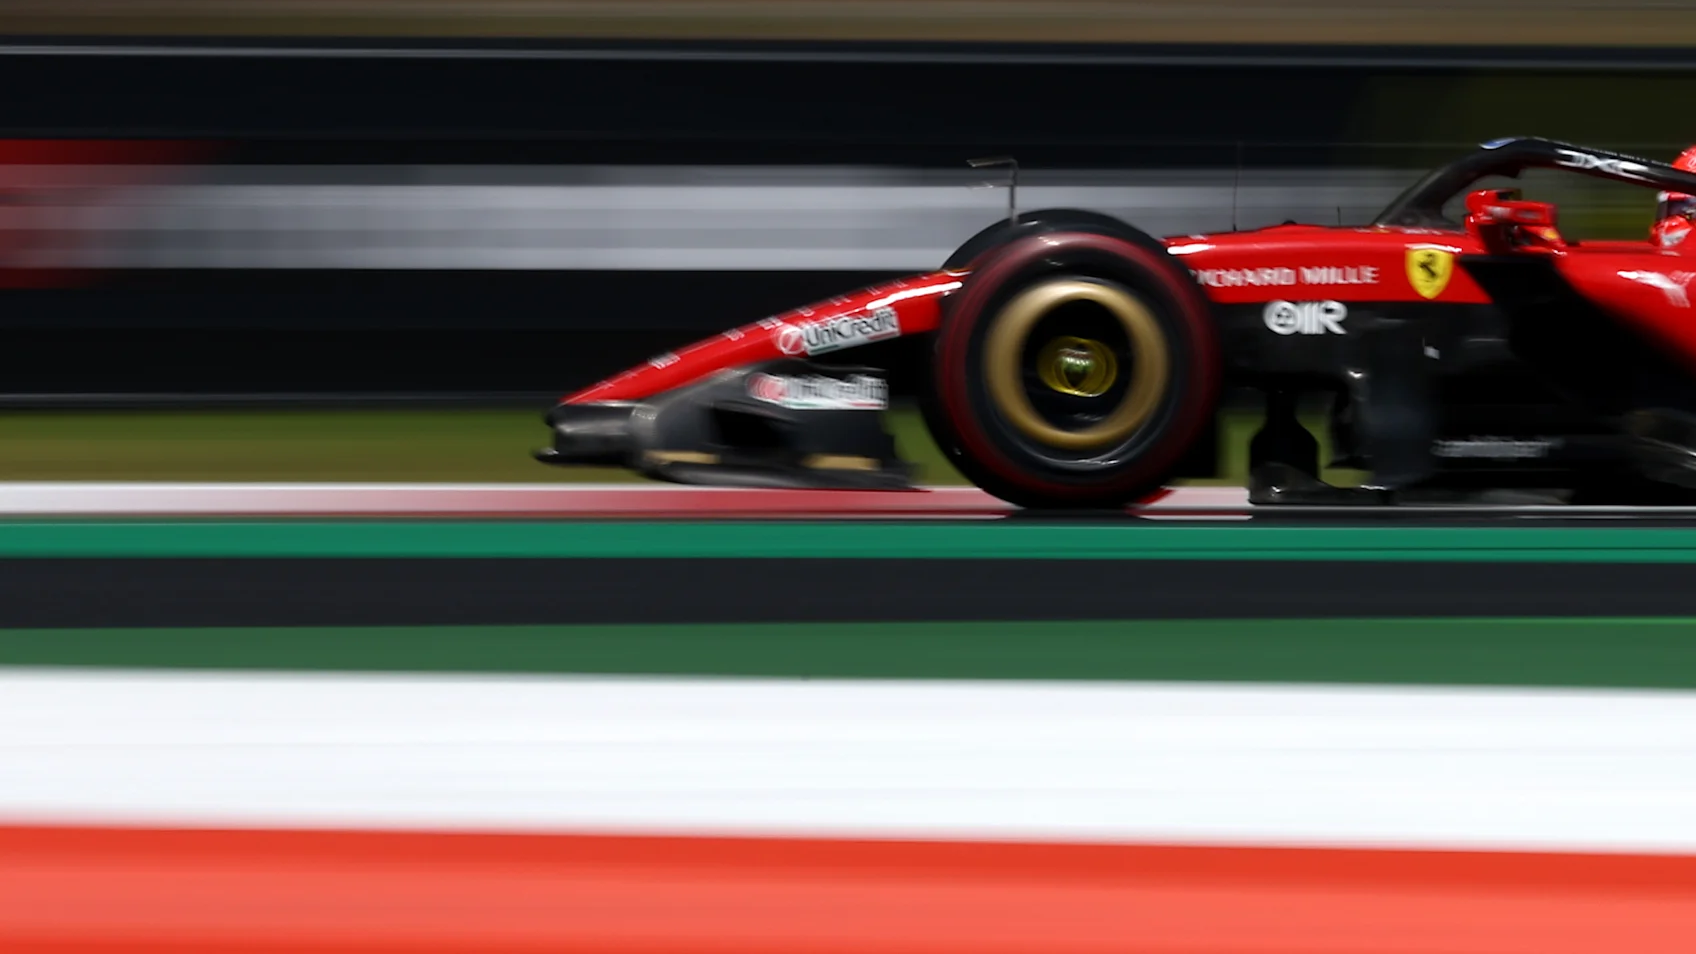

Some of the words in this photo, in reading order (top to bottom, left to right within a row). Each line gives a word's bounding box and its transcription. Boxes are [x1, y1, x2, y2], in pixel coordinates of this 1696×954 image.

[1188, 267, 1296, 287] ICHARD
[1299, 265, 1380, 285] MILLE
[805, 309, 898, 347] UniCredit
